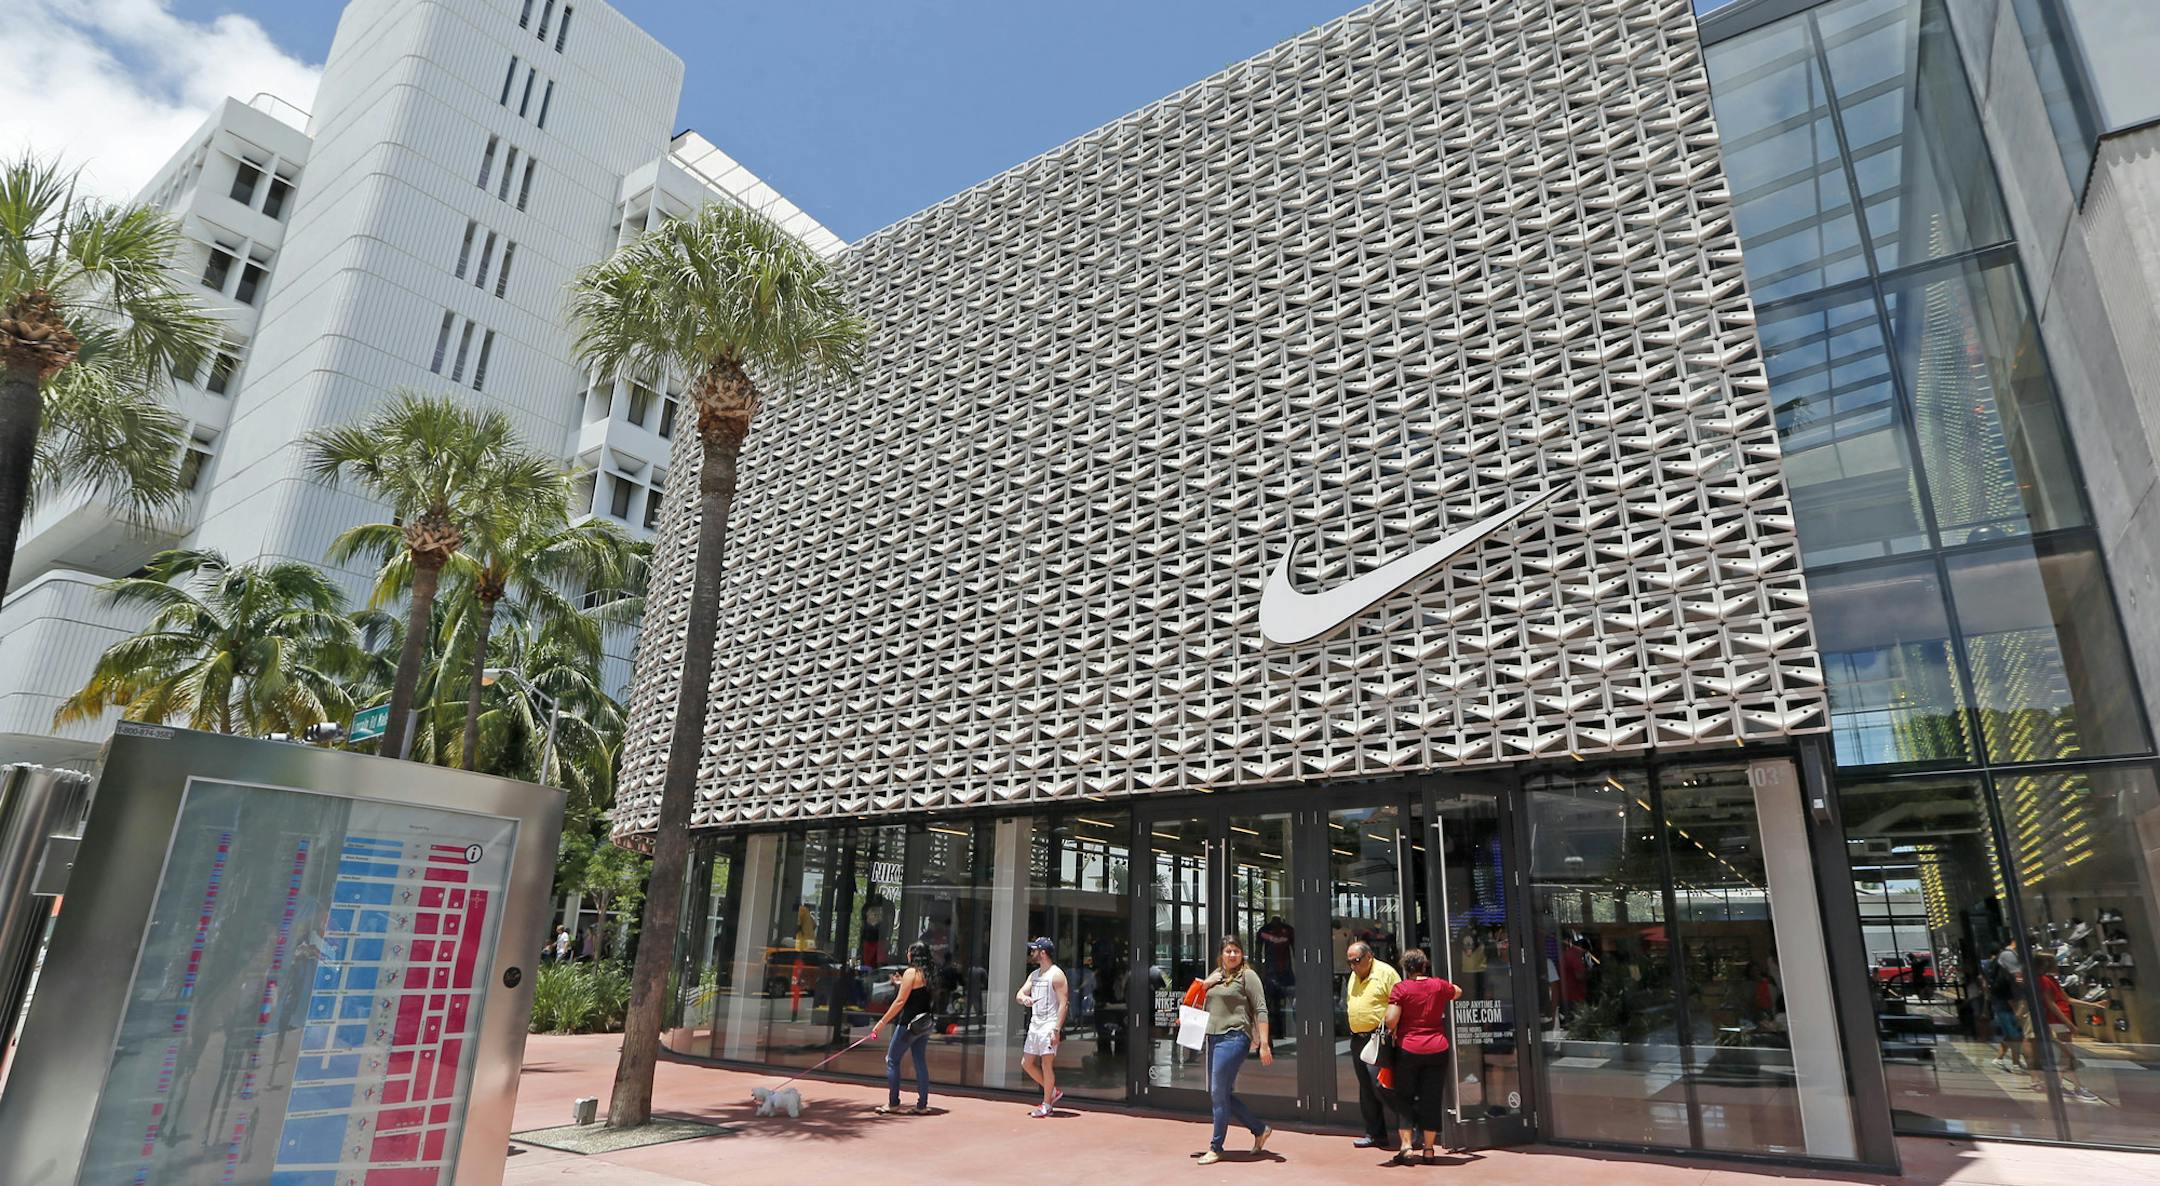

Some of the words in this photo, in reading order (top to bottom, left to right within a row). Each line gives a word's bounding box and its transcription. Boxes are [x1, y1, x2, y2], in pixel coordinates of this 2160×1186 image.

[1154, 997, 1184, 1010] NIKE.C
[1455, 1000, 1469, 1009] SHOP
[1470, 1000, 1494, 1009] ANYTIME
[1494, 1000, 1501, 1008] AT
[1456, 1008, 1502, 1024] NIKE.COM
